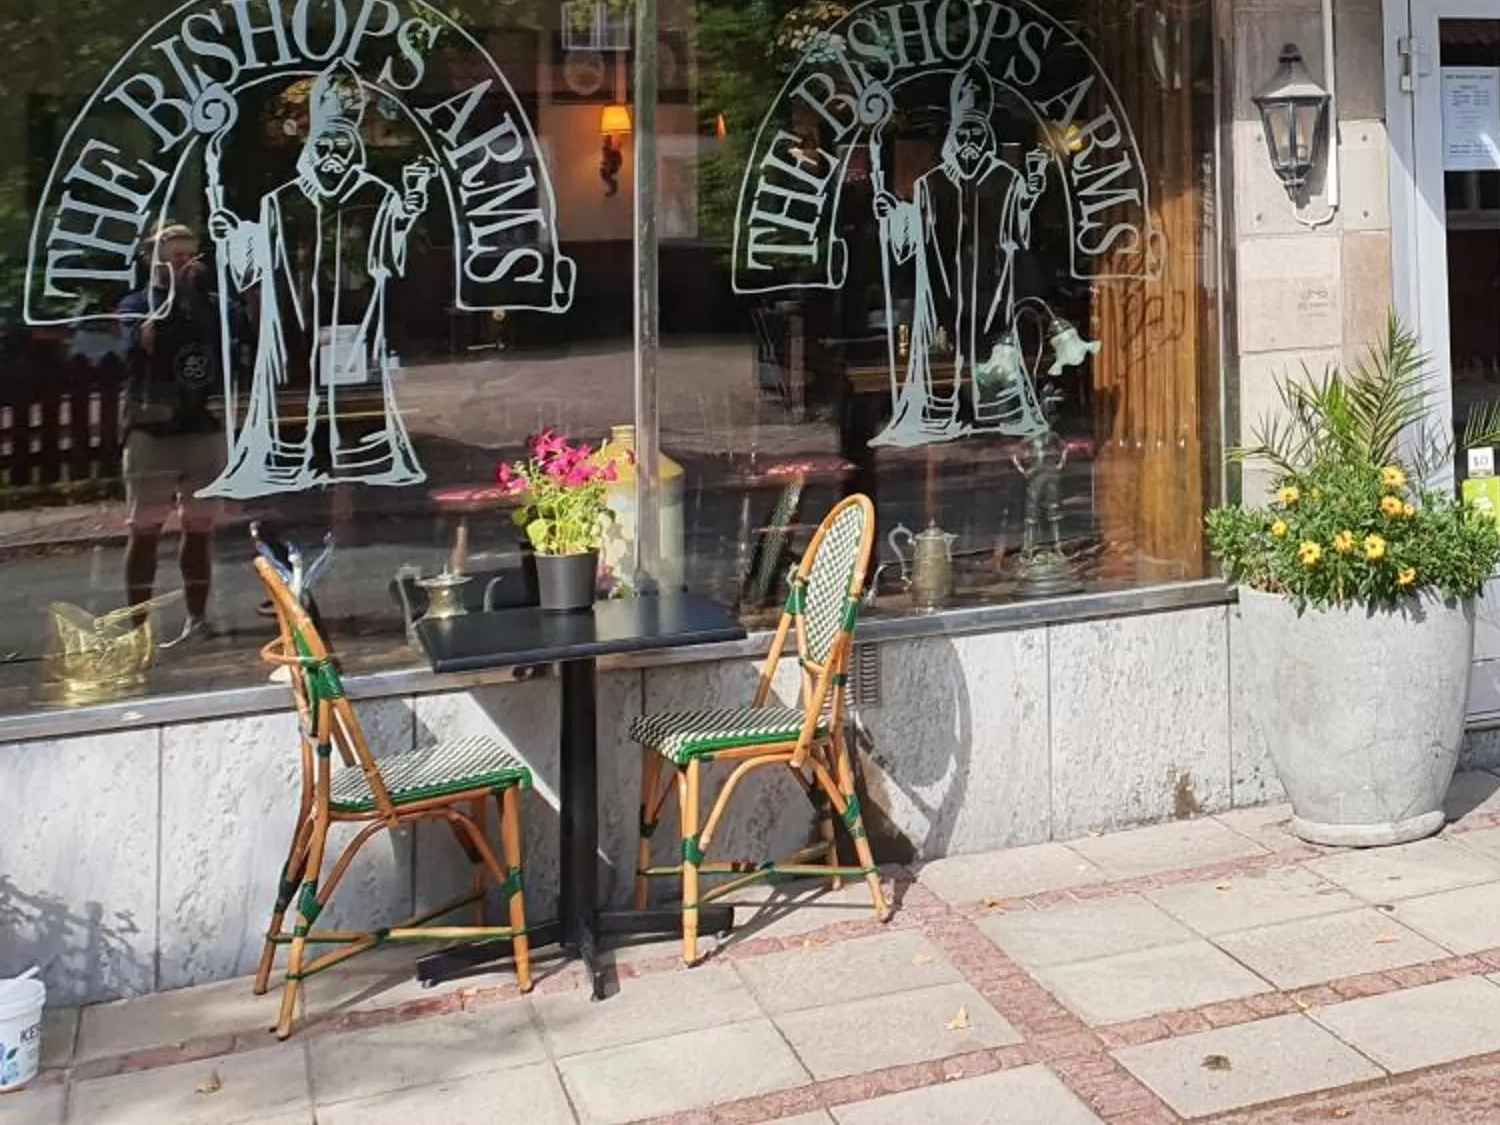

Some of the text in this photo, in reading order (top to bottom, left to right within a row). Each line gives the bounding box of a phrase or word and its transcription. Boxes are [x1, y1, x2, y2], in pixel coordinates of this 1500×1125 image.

[44, 139, 168, 299] THE
[416, 79, 547, 284] ARMS
[746, 131, 841, 271] THE
[1035, 77, 1142, 255] ARMS
